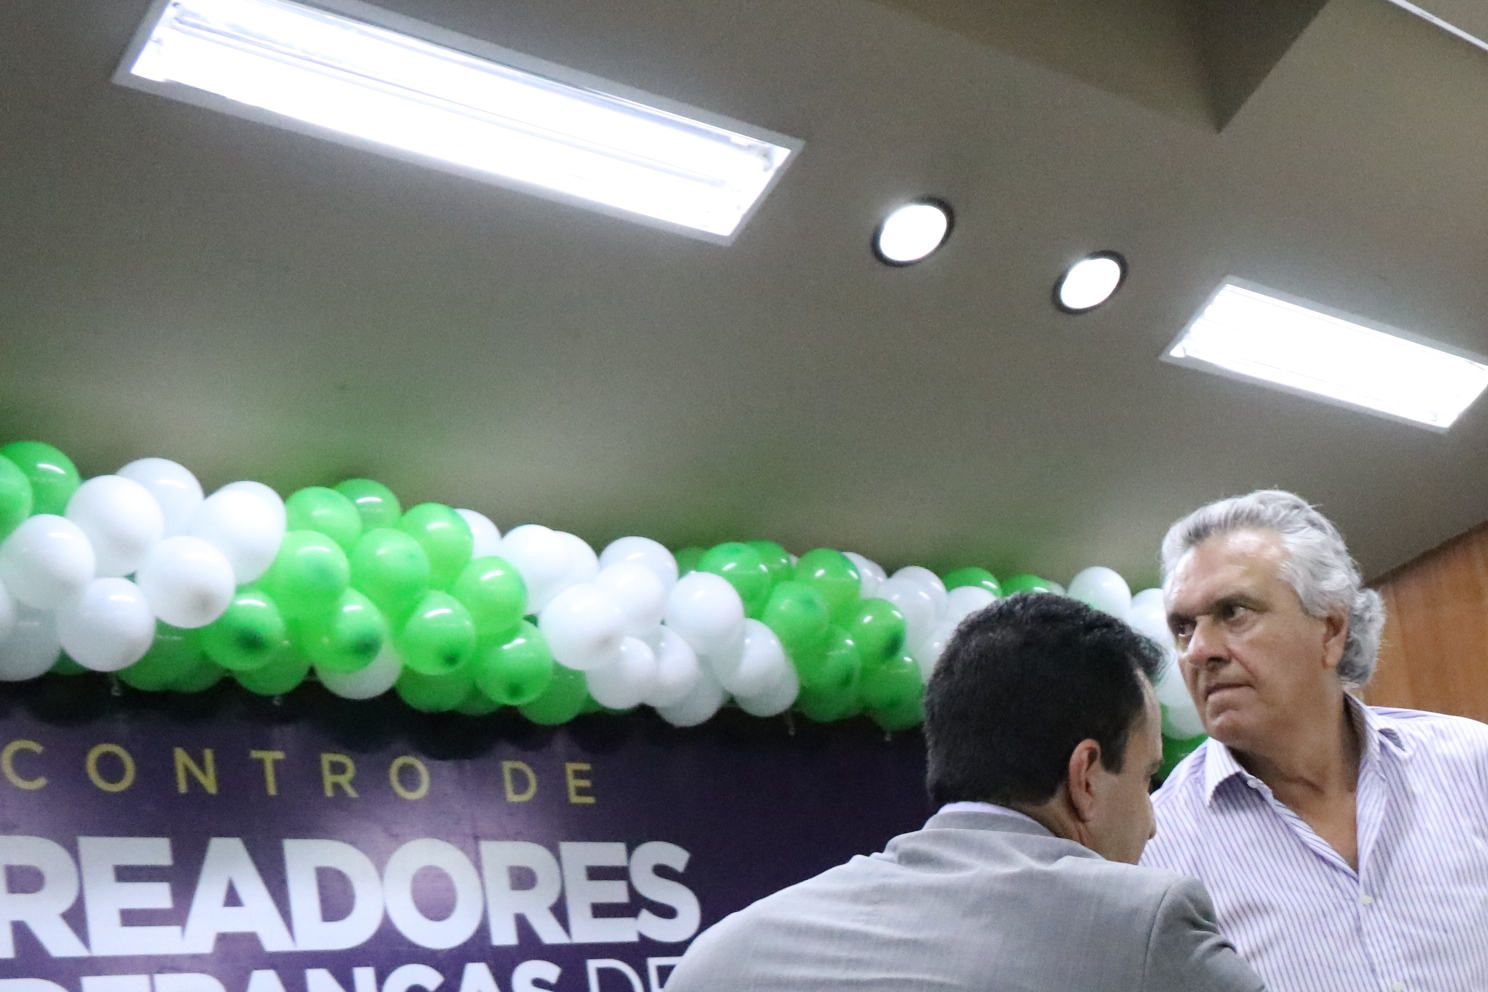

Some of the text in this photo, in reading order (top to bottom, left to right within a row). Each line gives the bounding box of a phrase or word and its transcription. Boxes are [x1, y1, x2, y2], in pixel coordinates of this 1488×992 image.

[1, 739, 597, 804] CONTRO DE
[0, 834, 702, 959] READORES
